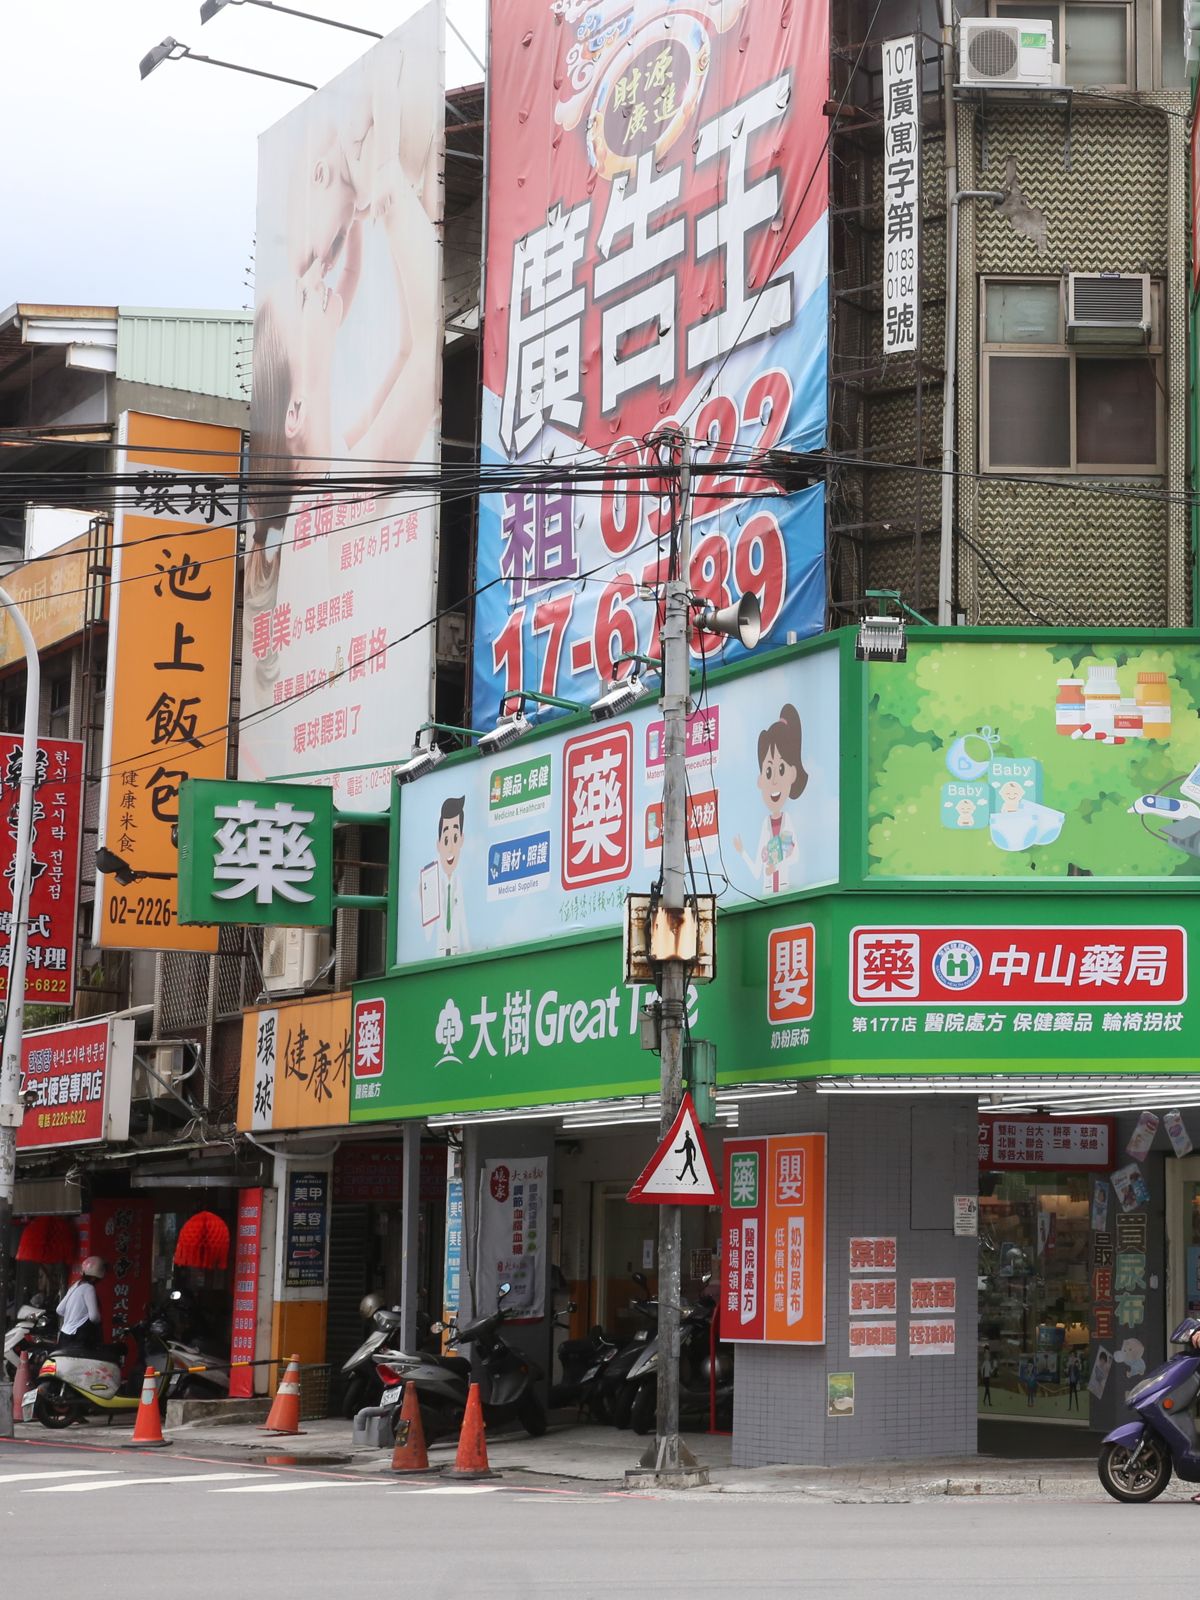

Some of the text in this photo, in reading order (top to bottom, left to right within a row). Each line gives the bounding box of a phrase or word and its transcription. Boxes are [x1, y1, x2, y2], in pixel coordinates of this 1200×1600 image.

[500, 72, 793, 458] 廣告王
[340, 512, 418, 570] 最好的月子餐
[252, 591, 354, 659] 專業的母嬰照護
[293, 704, 361, 753] 環球聽到了
[947, 784, 983, 797] Baby
[992, 763, 1031, 777] Baby
[118, 770, 138, 853] 健康米食
[494, 809, 515, 821] Medicine
[519, 801, 545, 816] Healthcare
[571, 748, 623, 864] 藥
[212, 800, 317, 904] 藥
[498, 880, 539, 895] Medical Supplies
[559, 885, 630, 922] 值得您信賴的藥
[773, 936, 808, 1010] 嬰
[863, 940, 915, 992] 藥
[989, 944, 1168, 987] 中山藥局
[357, 1011, 381, 1068] 藥
[469, 984, 698, 1059] 大樹 Great Tre
[771, 1027, 810, 1049] 奶粉尿布
[852, 1013, 1184, 1033] 第177店 醫院處方 保健藥品 輪椅拐杖
[254, 1016, 275, 1123] 環球
[355, 1082, 382, 1099] 醫院處方
[38, 1110, 86, 1127] 電話 2226-6822
[294, 1187, 322, 1200] 美甲
[732, 1158, 756, 1203] 藥
[779, 1155, 801, 1200] 嬰
[293, 1212, 321, 1226] 美容
[727, 1228, 739, 1312] 現場領藥
[743, 1226, 755, 1312] 醫院處方
[774, 1227, 785, 1312] 低價供應
[790, 1227, 801, 1312] 奶粉尿布
